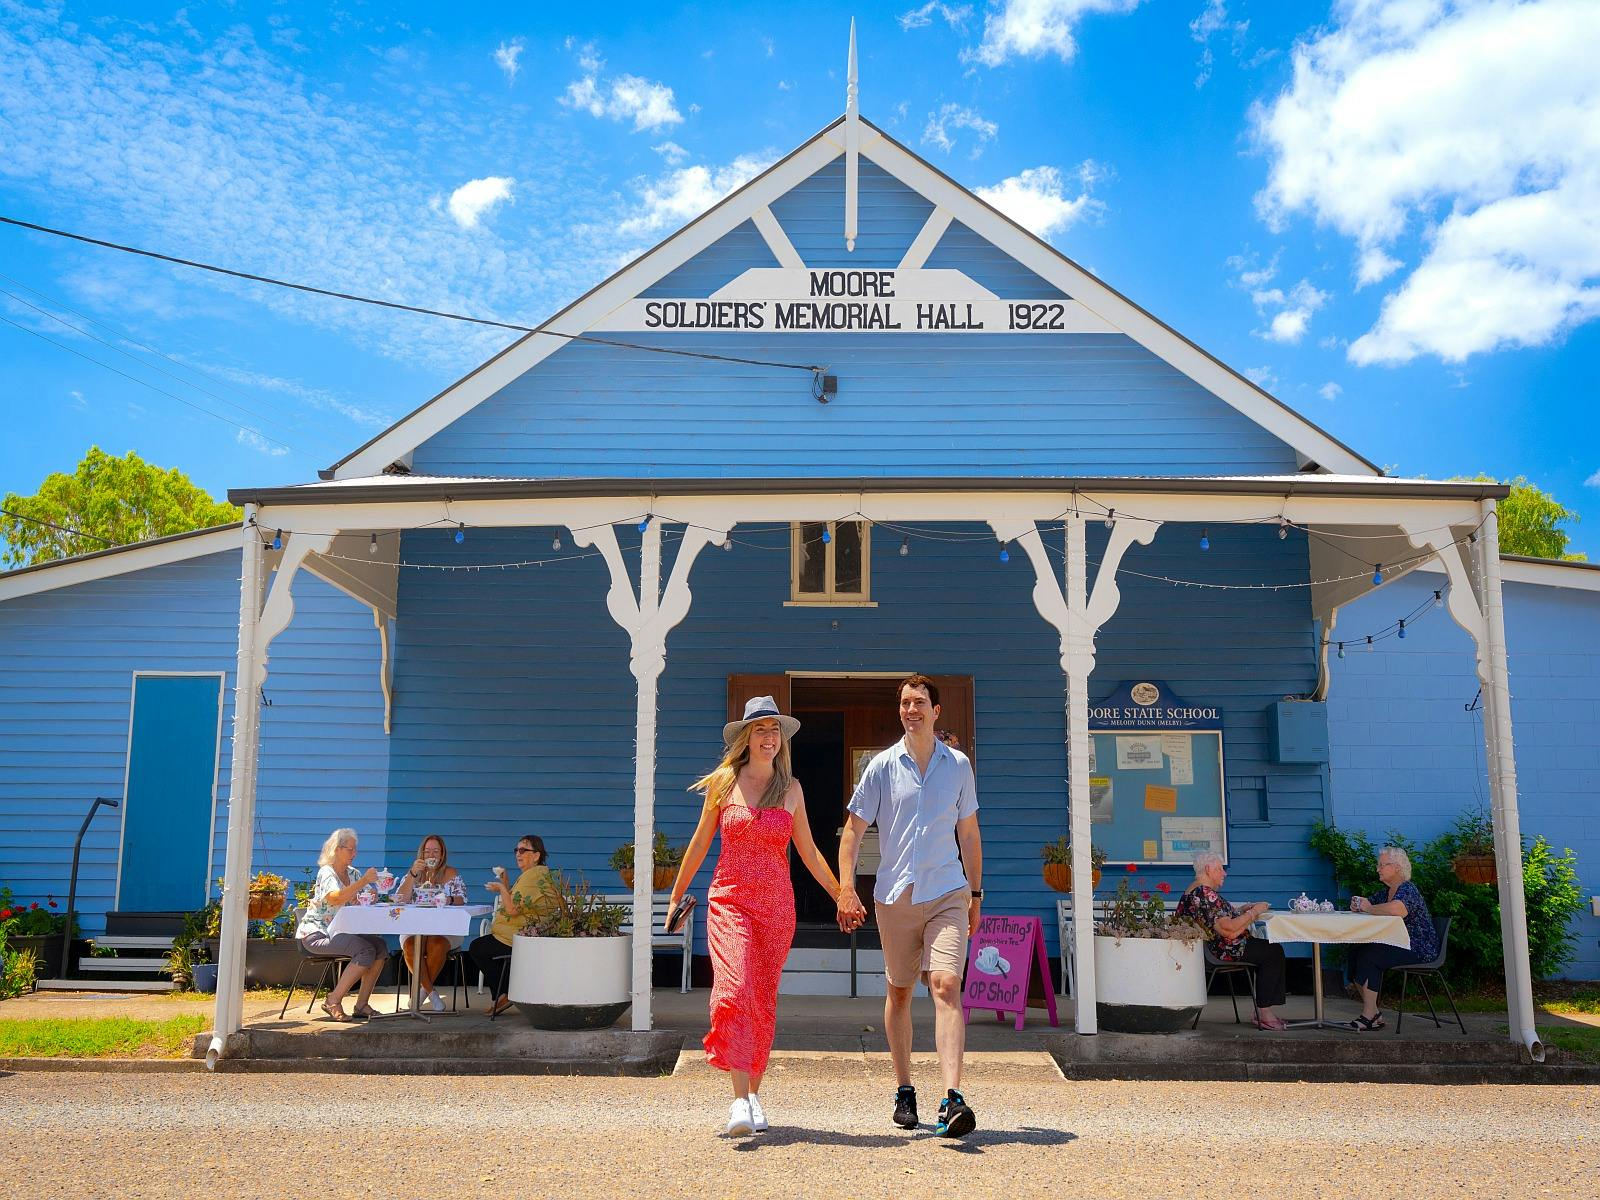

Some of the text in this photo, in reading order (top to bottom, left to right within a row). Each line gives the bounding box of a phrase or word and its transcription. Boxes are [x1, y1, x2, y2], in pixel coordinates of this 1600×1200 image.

[810, 271, 895, 297] MOORE
[645, 301, 1065, 330] SOLDIERS' MEMORIAL HALL 1922
[1088, 707, 1220, 719] OORE STATE SCHOOL
[969, 981, 986, 999] OP
